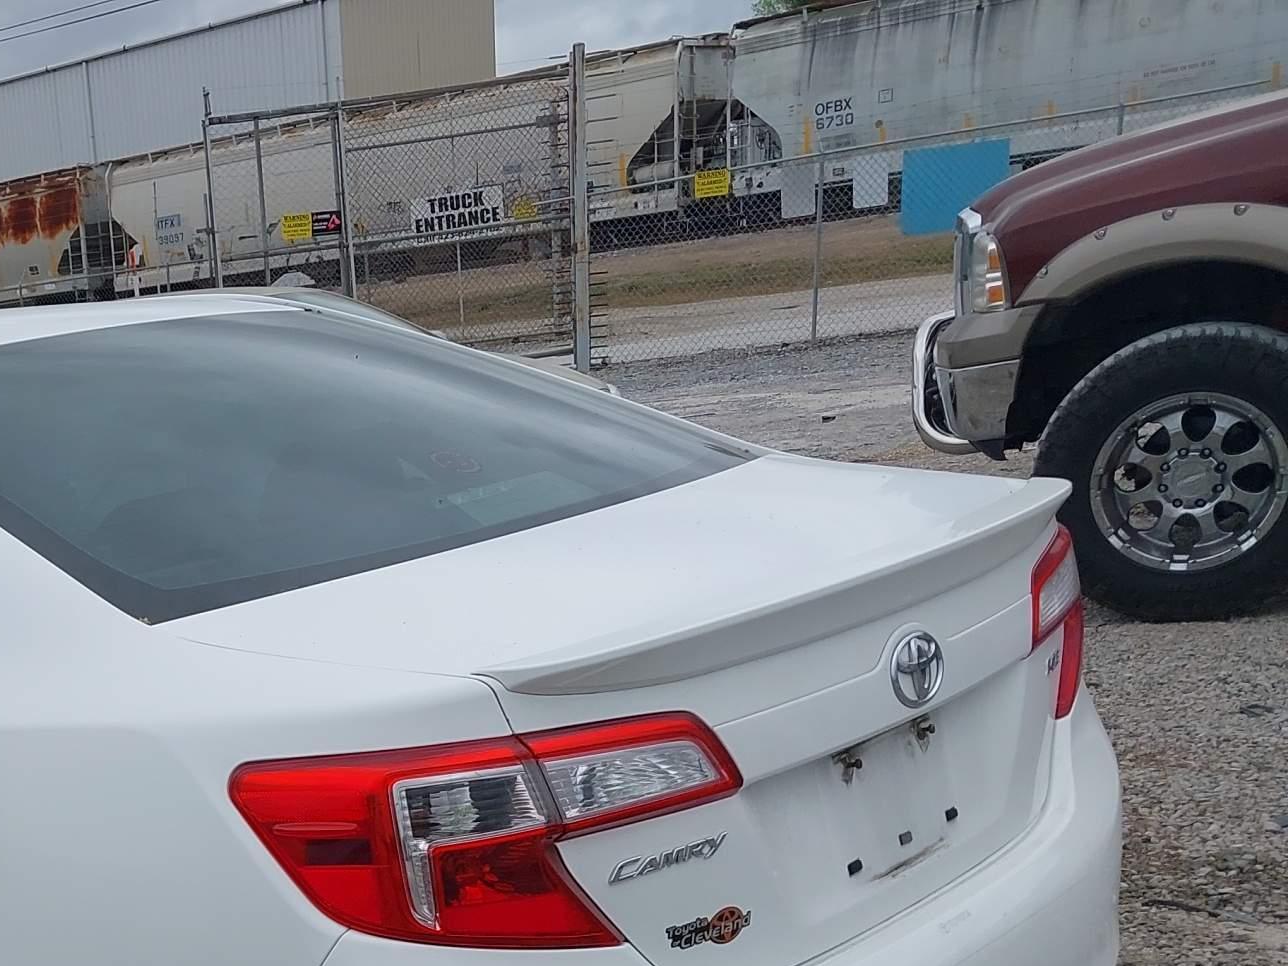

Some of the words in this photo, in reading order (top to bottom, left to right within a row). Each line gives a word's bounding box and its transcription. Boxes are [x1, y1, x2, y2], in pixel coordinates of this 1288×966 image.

[815, 97, 852, 116] OFBX
[816, 113, 854, 130] 6730
[427, 191, 484, 214] TRUCK
[415, 207, 500, 233] ENTRANCE
[608, 831, 728, 885] CAMRY
[667, 917, 709, 939] Toyota
[680, 911, 751, 949] Cleveland
